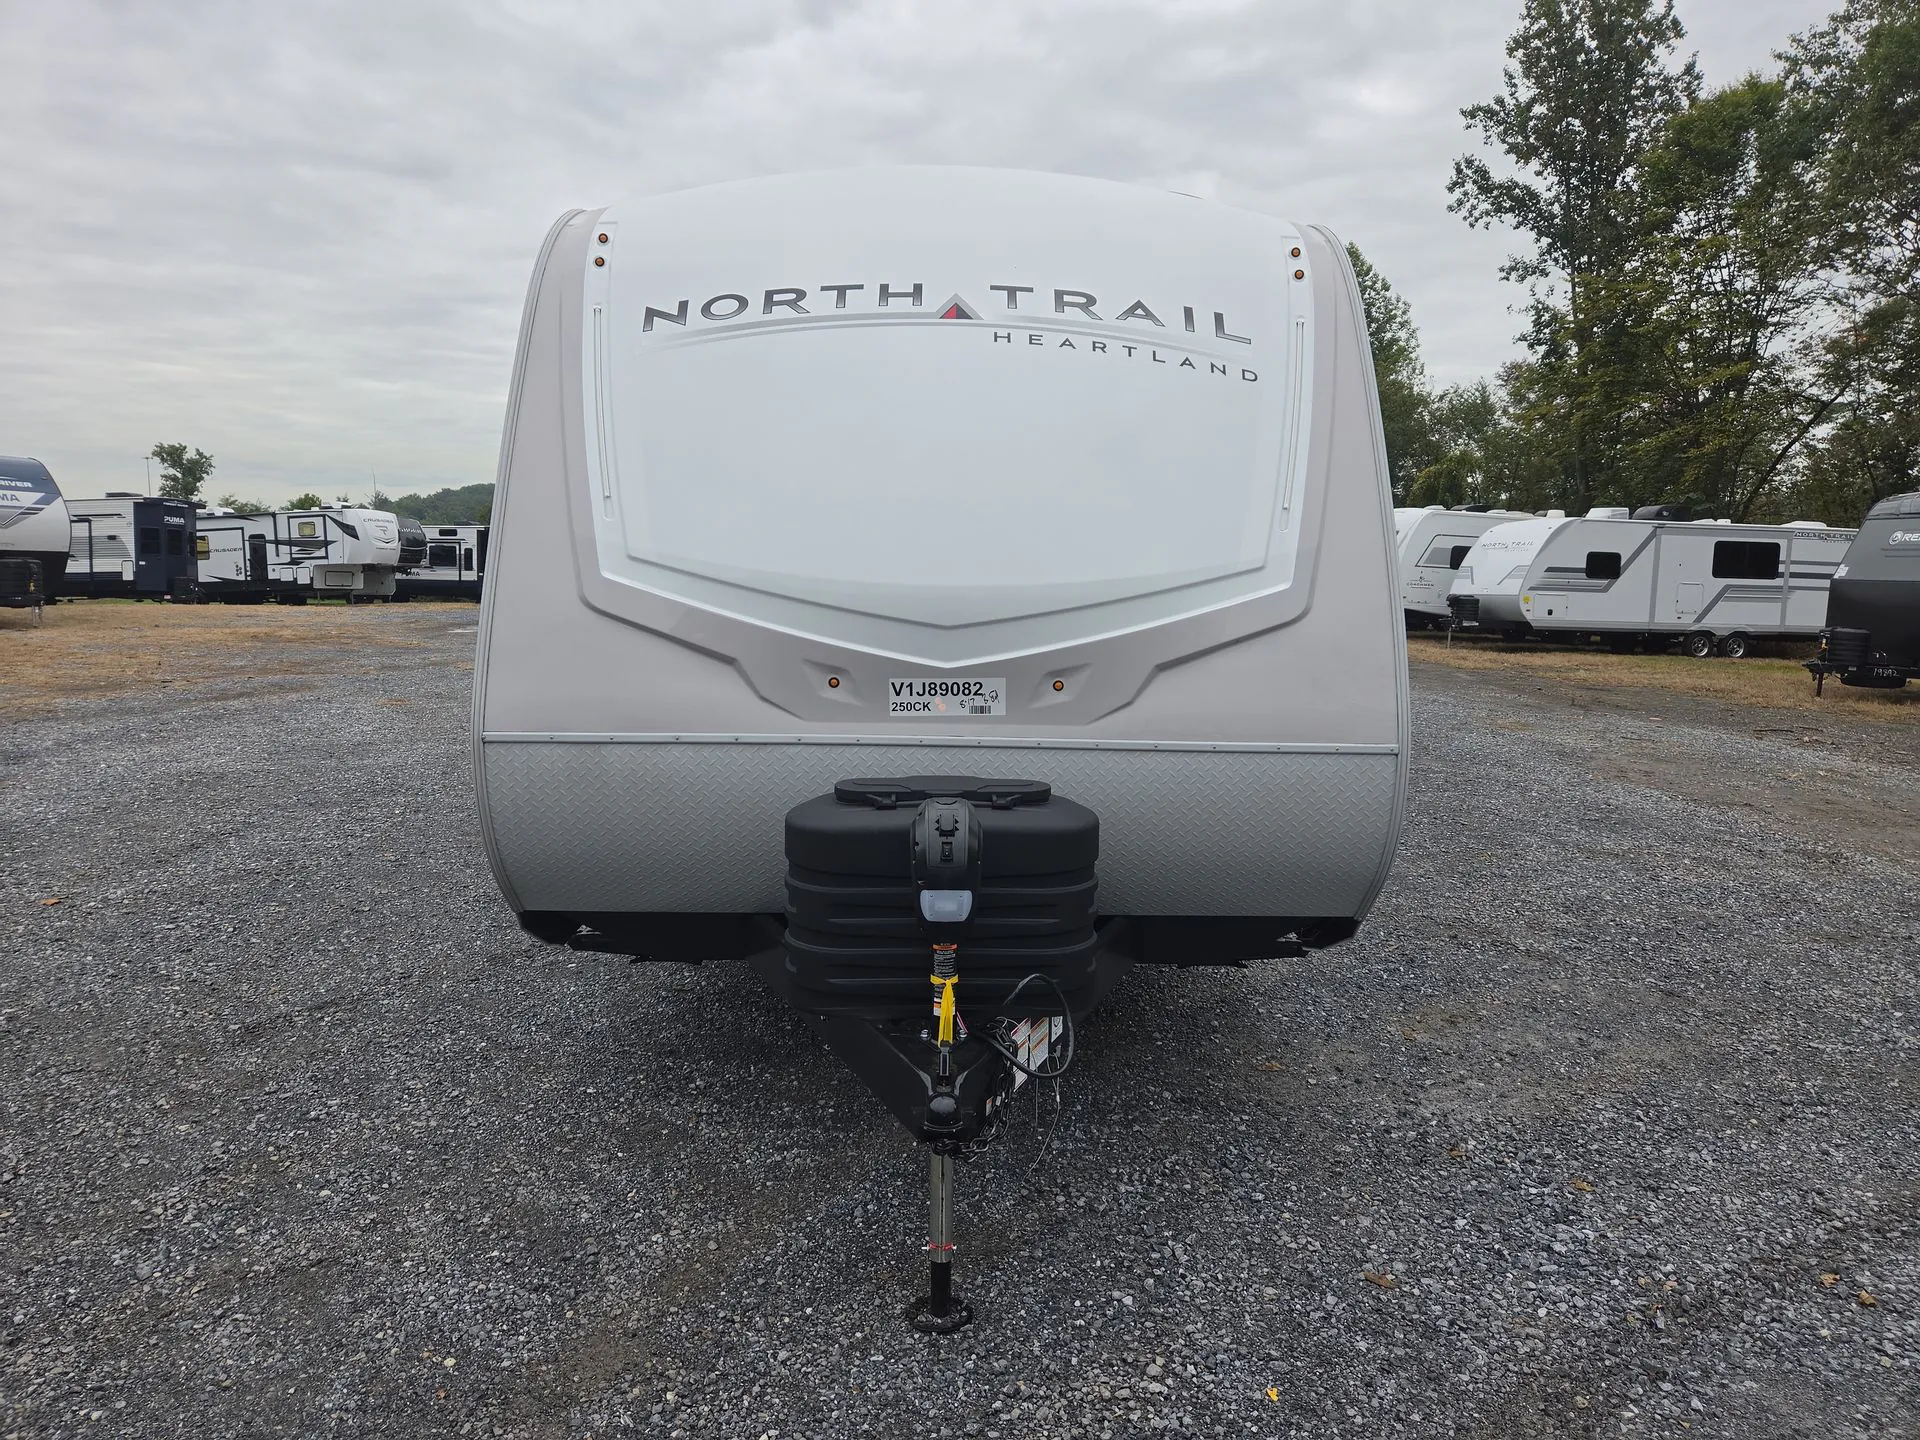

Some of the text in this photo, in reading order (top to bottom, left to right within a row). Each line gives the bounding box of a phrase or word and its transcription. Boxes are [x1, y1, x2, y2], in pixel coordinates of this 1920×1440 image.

[642, 282, 1252, 346] NORTH TRAIL
[992, 330, 1260, 384] HEARTLAND
[163, 515, 185, 523] PUMA
[891, 682, 984, 697] V1J89082
[891, 701, 932, 712] 250CK
